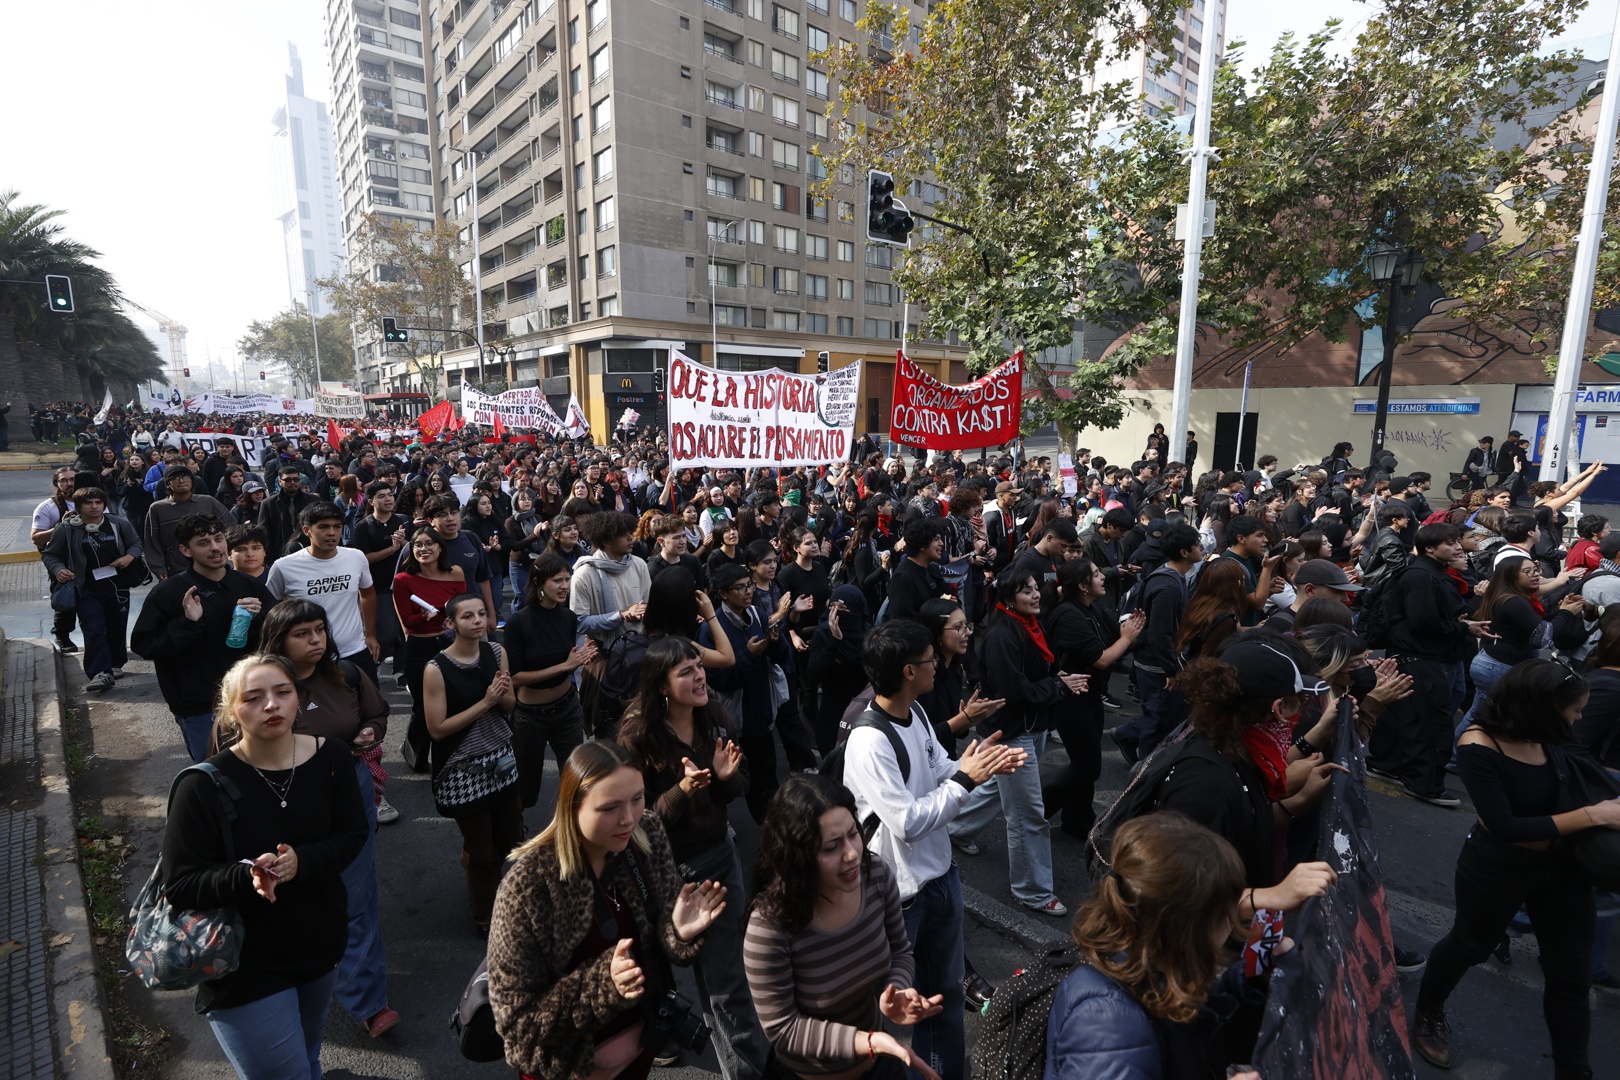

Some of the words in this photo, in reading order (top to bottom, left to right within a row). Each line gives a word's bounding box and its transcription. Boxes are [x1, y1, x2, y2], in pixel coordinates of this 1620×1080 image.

[671, 359, 708, 402] QUE
[712, 374, 738, 407] LA
[744, 374, 816, 413] HISTORIA
[466, 400, 476, 409] LOS
[479, 402, 525, 415] ESTUDIANTES
[474, 410, 491, 423] CON
[1390, 404, 1427, 412] ESTAMOS
[1429, 404, 1473, 412] ATENDIENDO
[893, 405, 950, 435] CONTRA
[749, 426, 762, 459] EL
[764, 425, 845, 461] PENSAMIENTO
[1550, 444, 1559, 468] 415
[306, 574, 351, 587] EARNED
[307, 582, 349, 595] GIVEN
[632, 867, 648, 900] DIGITAL
